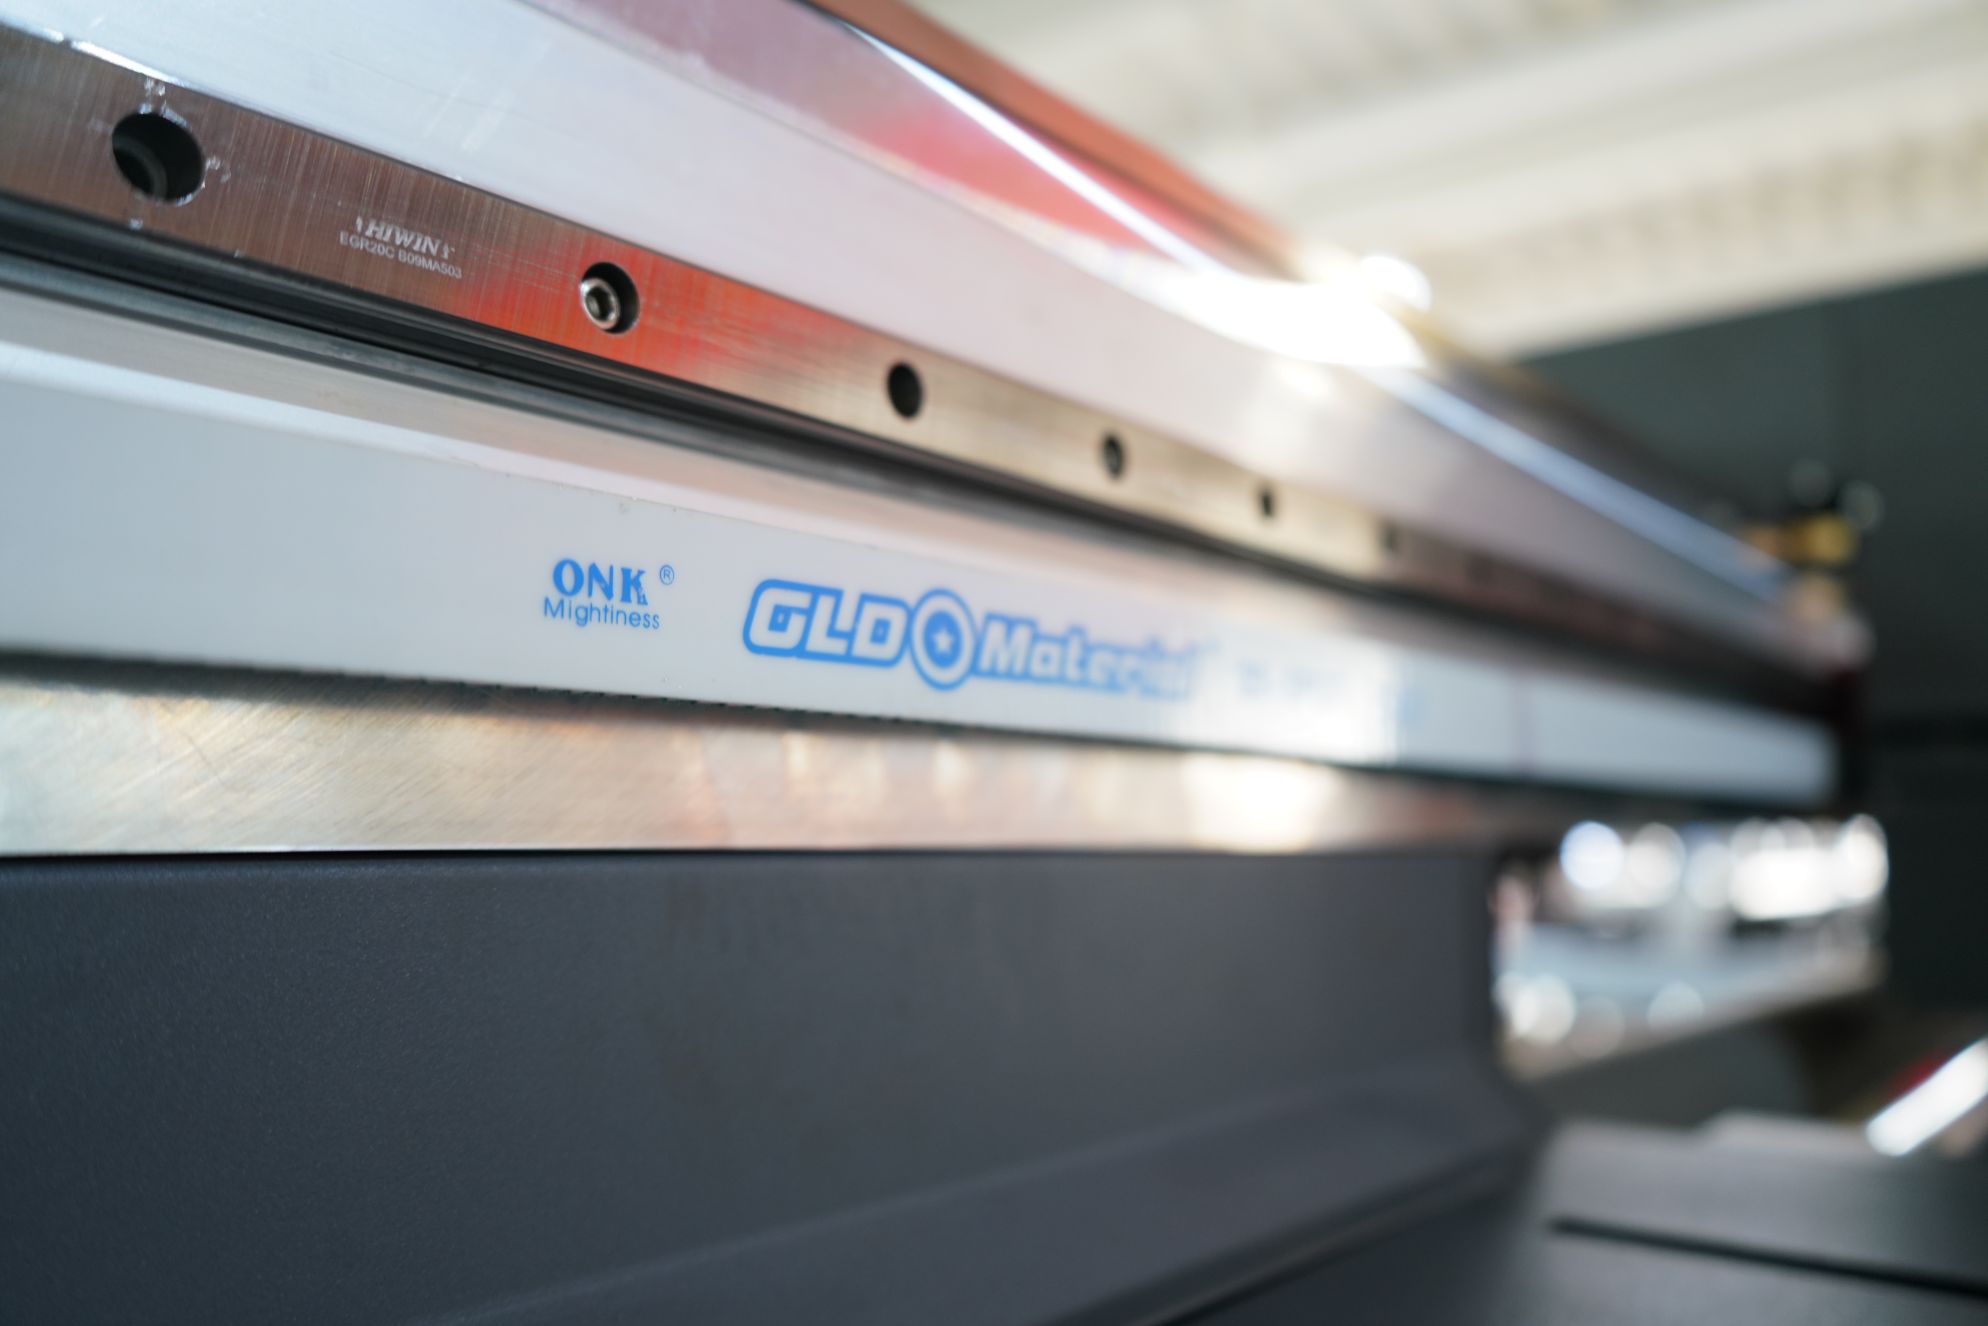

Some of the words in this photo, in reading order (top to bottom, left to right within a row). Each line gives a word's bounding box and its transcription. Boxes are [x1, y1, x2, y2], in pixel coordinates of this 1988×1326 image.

[365, 218, 441, 256] HIWIN
[552, 558, 648, 606] ONK
[543, 596, 660, 629] Mightiness
